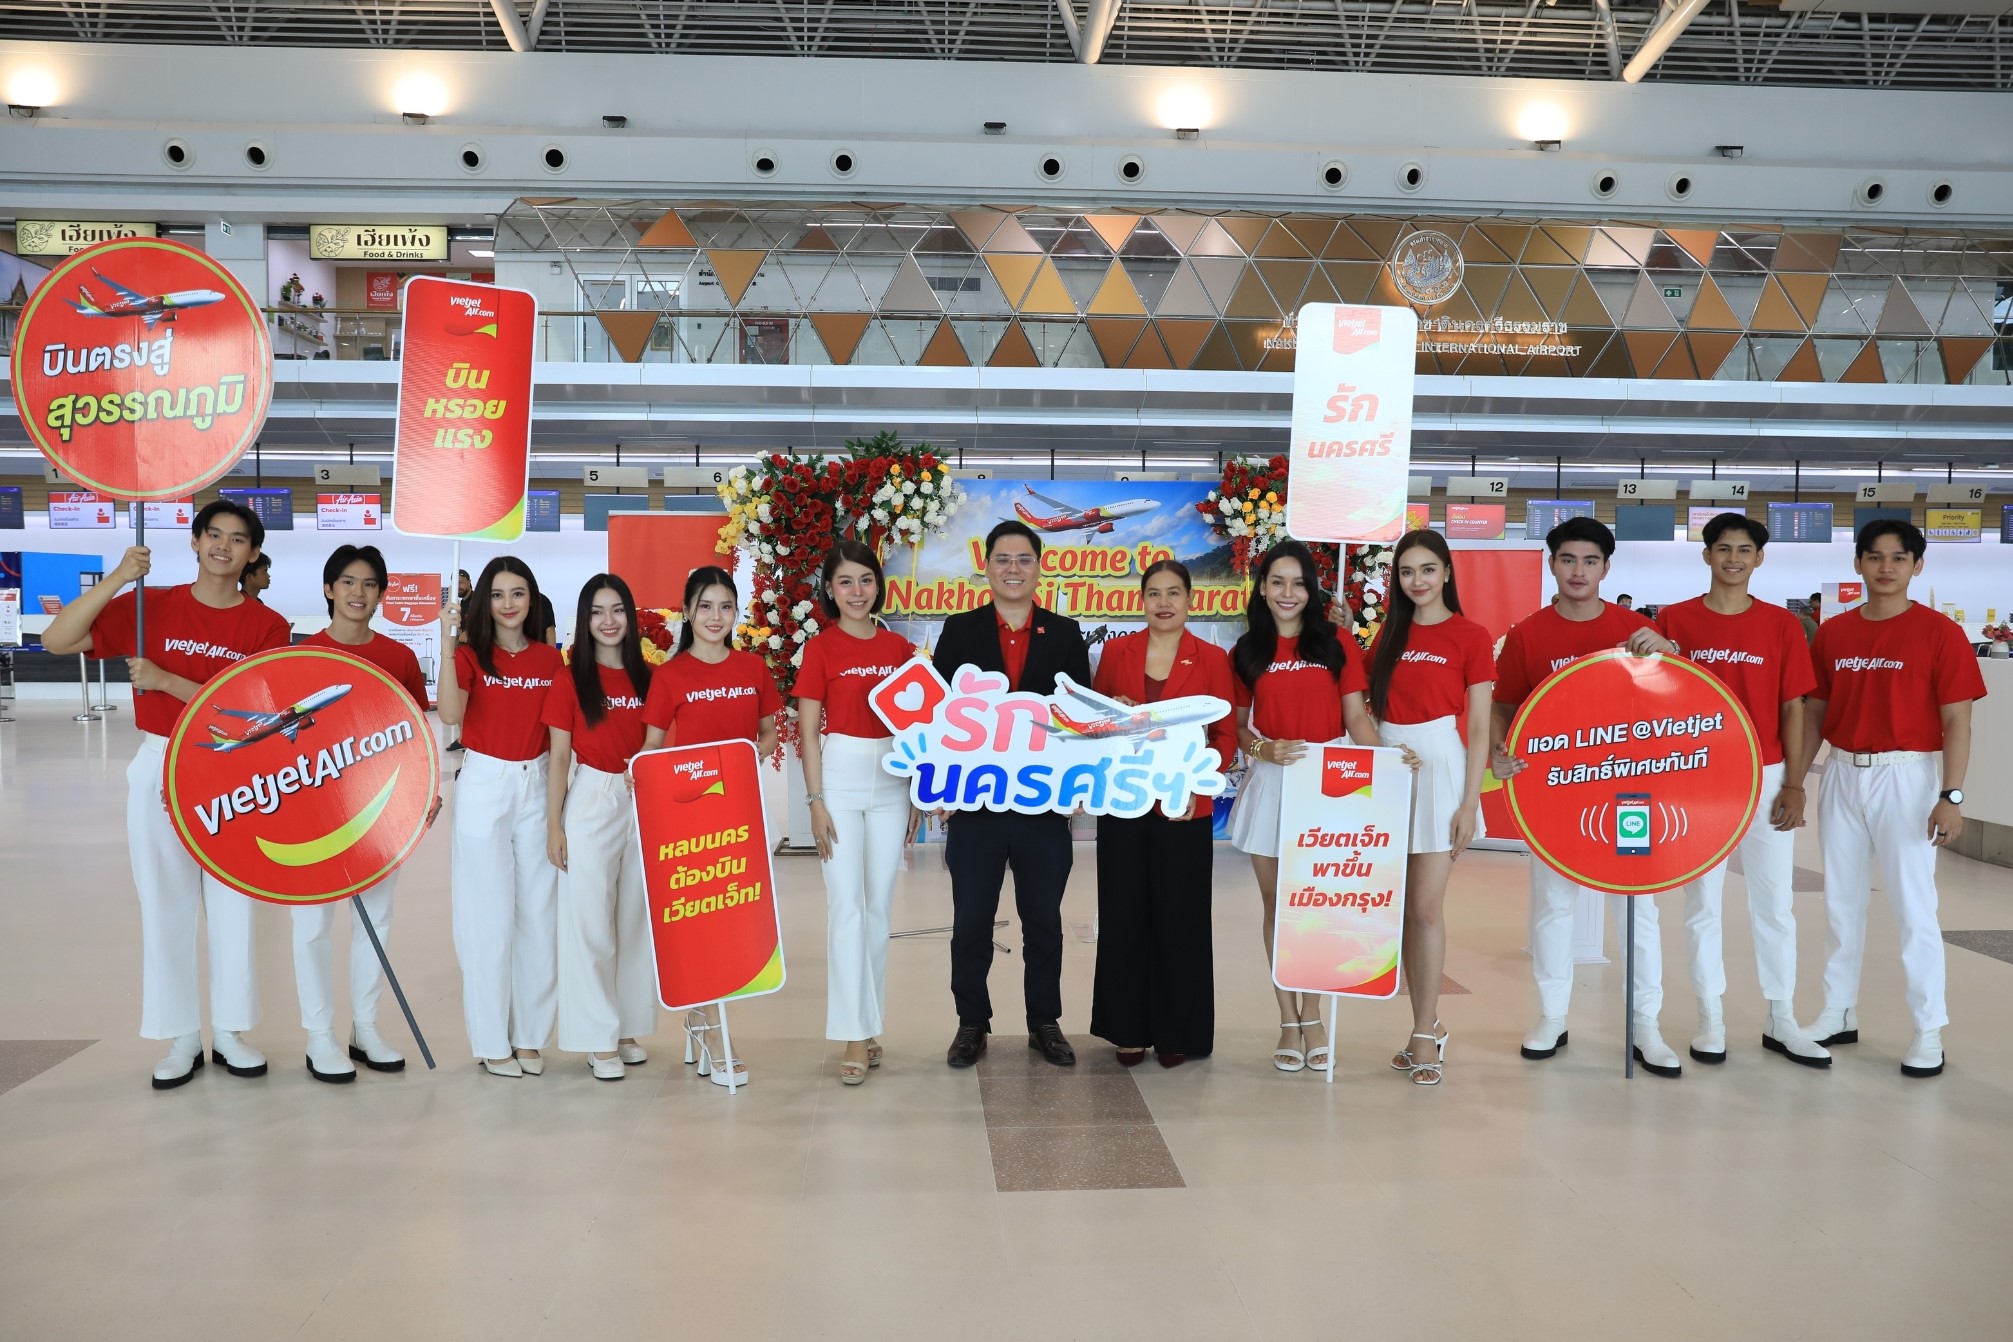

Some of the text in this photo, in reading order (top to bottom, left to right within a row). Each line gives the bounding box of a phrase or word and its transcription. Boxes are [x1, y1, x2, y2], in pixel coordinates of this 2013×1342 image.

[356, 228, 431, 247] เฮียเพ้ง
[363, 250, 385, 258] Food
[395, 251, 424, 259] Drinks
[43, 328, 174, 377] บินตรงสู่
[1421, 341, 1582, 357] INTERNATIONAL AIRPORT
[445, 362, 490, 389] บิน
[46, 373, 247, 442] สุวรรณภูมิ
[423, 398, 507, 420] หรอย
[1322, 383, 1380, 424] รัก
[433, 428, 493, 449] แรง
[1307, 431, 1395, 459] นครศรี
[320, 469, 331, 480] 3
[589, 470, 599, 482] 5
[713, 472, 723, 483] 6
[1489, 481, 1504, 492] 12
[1622, 483, 1637, 494] 13
[1731, 485, 1745, 496] 14
[1862, 487, 1876, 498] 15
[1968, 488, 1982, 499] 16
[886, 579, 995, 611] Nakho
[1064, 580, 1250, 613] Thamarat
[400, 607, 411, 622] 7
[483, 675, 553, 690] VietjetAir.co
[686, 686, 757, 703] VietjetAir.co
[941, 671, 1050, 752] รัก
[1527, 712, 1724, 754] แอด LINE @Vietjet
[1546, 746, 1709, 787] รับสิทธิ์พิเศษทันที
[916, 748, 1186, 812] นครศรีฯ
[658, 824, 749, 862] หลบนคร
[1296, 824, 1390, 849] เวียตเจ็ท
[669, 855, 747, 890] ต้องบิน
[1311, 850, 1373, 878] พาขึ้น
[663, 881, 762, 924] เวียตเจ็ท!
[1288, 886, 1393, 914] เมืองกรุง!
